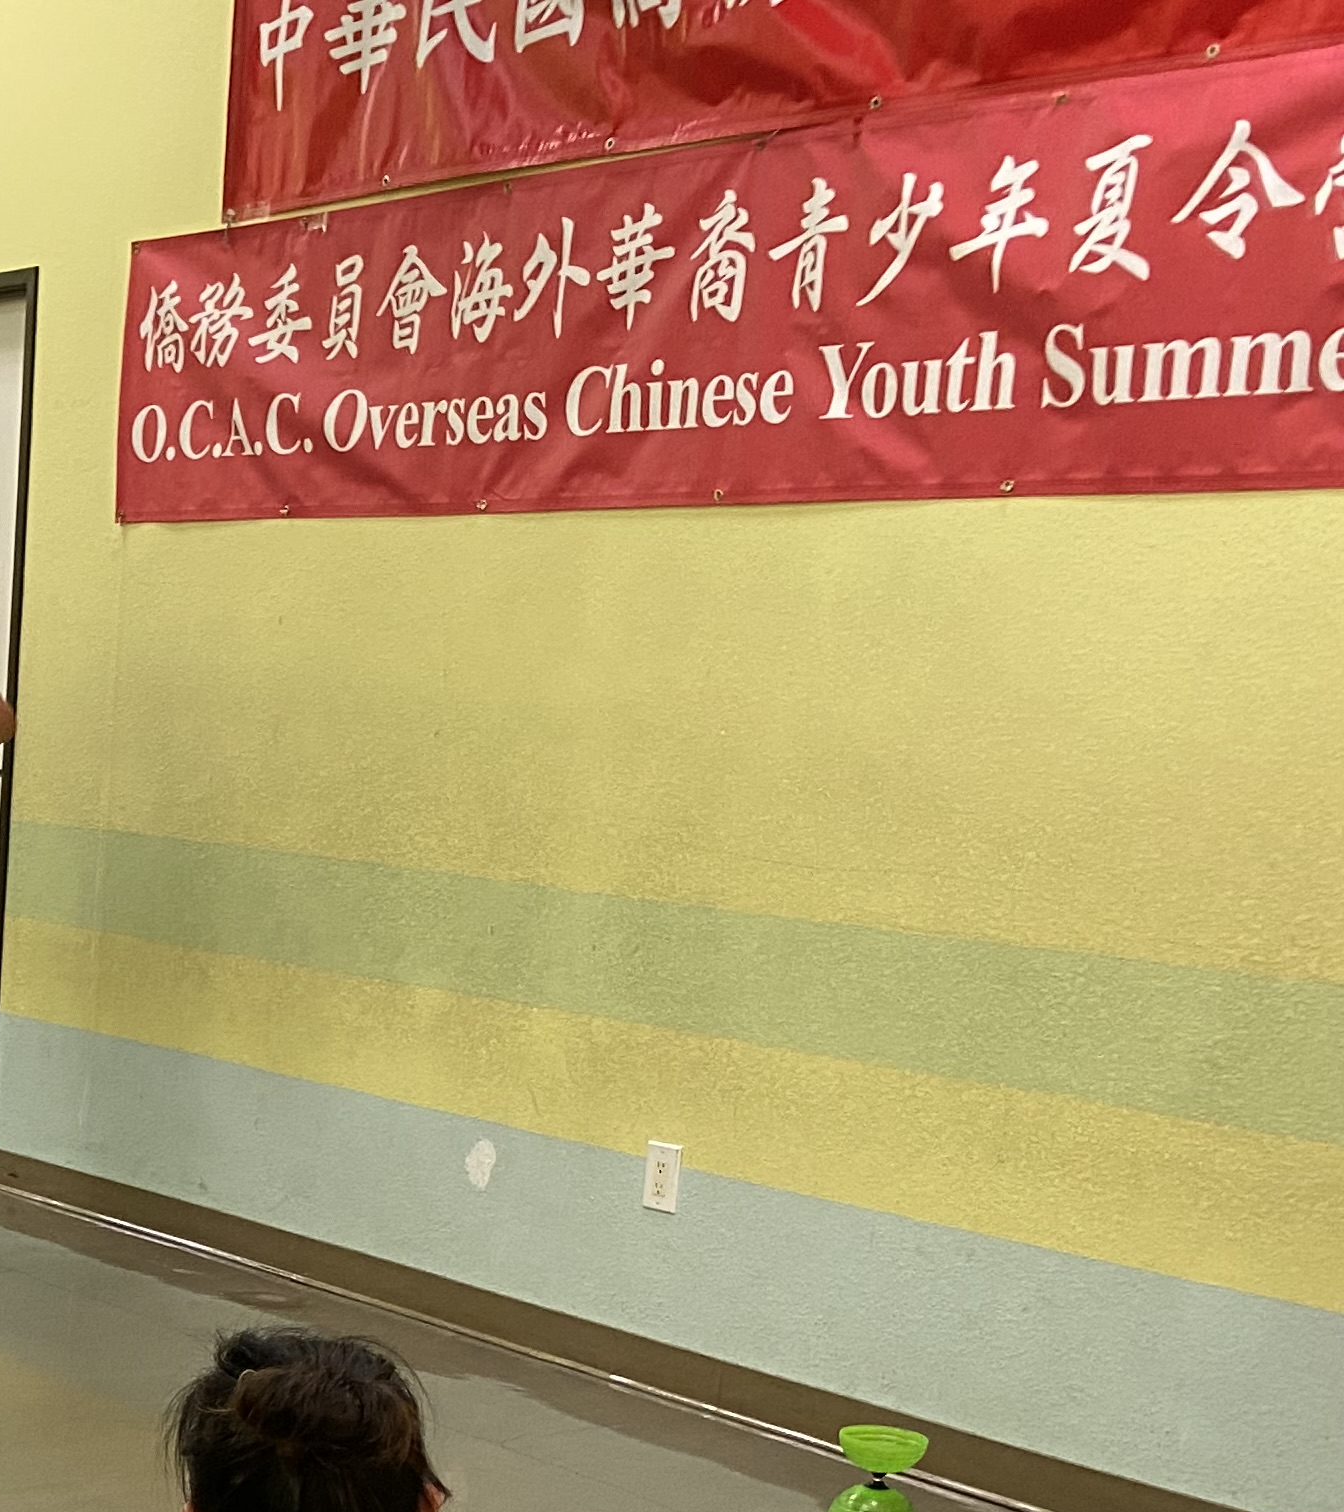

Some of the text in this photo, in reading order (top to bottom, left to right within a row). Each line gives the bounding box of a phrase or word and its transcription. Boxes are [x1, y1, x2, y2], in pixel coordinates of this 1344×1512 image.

[131, 392, 313, 463] O.C.A.C.
[323, 389, 548, 453] Overseas
[564, 359, 794, 438] Chinese
[818, 331, 1016, 420] Youth
